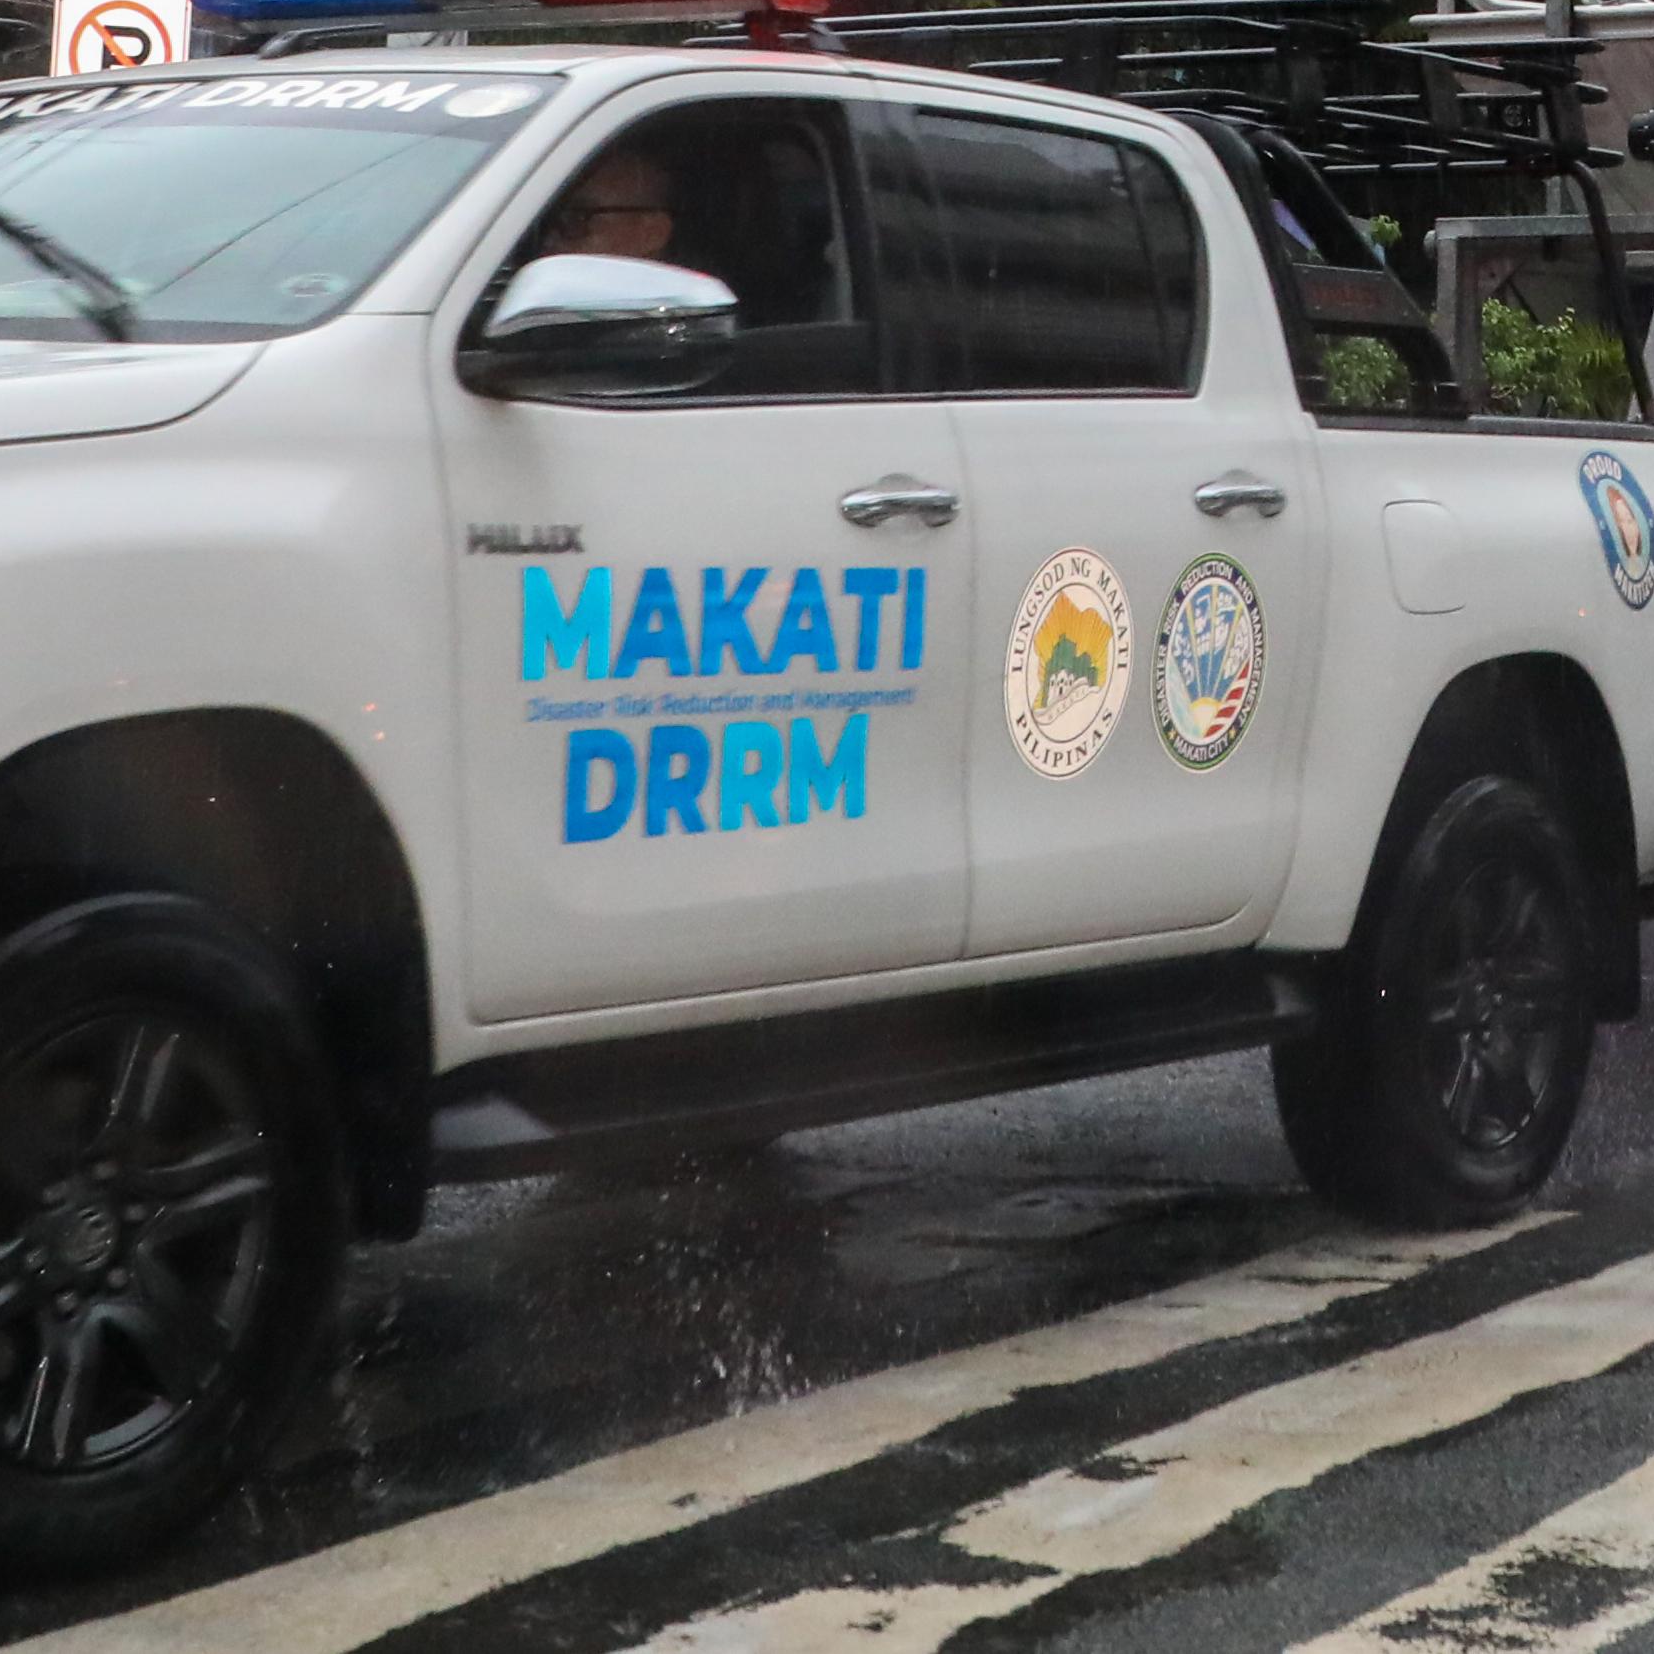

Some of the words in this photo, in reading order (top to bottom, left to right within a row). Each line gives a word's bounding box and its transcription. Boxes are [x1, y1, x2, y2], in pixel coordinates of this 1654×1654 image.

[182, 80, 459, 112] DRRM
[1583, 454, 1622, 484] PROUD
[466, 523, 585, 554] HILUX
[1180, 560, 1233, 592] REDUCTION
[1235, 574, 1254, 605] AND
[522, 567, 926, 681] MAKATI
[1012, 563, 1065, 673] LUNGSOD
[1070, 557, 1091, 579] NG
[1097, 570, 1129, 670] MAKATI
[1164, 600, 1180, 635] RISK
[1239, 607, 1264, 728] MANAGEMENT
[761, 691, 795, 712] and
[1156, 645, 1169, 729] DISASTER
[1016, 710, 1113, 768] PILIPINAS
[1173, 735, 1207, 762] MAKATI
[1208, 737, 1230, 761] CITY
[563, 713, 869, 845] DRRM
